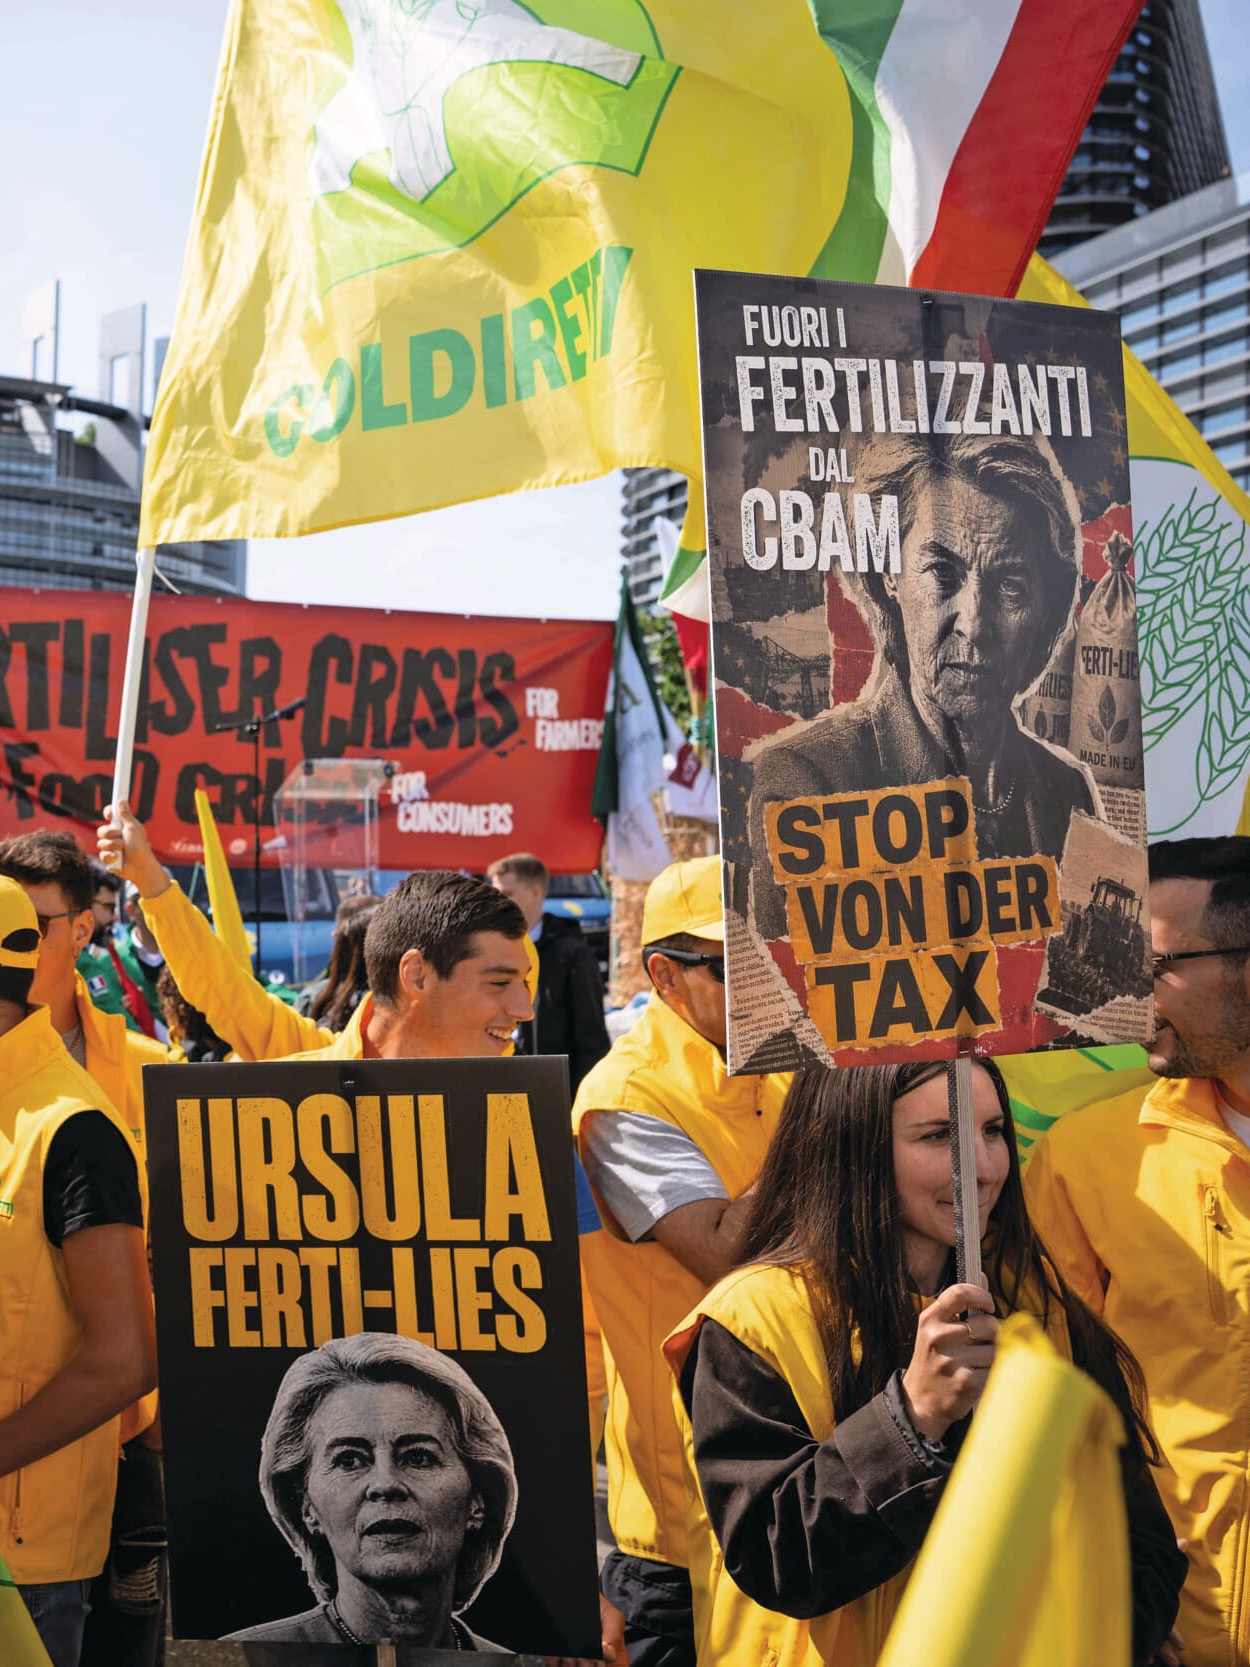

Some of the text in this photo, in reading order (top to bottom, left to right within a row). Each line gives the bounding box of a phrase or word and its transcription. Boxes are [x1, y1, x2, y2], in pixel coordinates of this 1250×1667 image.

[263, 245, 634, 459] COLDIRETTI
[742, 304, 847, 348] FUORI I
[735, 355, 1093, 438] FERTILIZZANTI
[808, 446, 854, 483] DAL
[740, 487, 902, 575] CBAM
[301, 632, 519, 760] CRISIS
[525, 687, 559, 719] FOR
[3, 742, 160, 828] FOOD
[391, 771, 429, 804] FOR
[1080, 750, 1136, 770] MADE IN EU
[397, 802, 513, 837] CONSUMERS
[776, 789, 970, 875] STOP
[796, 862, 1053, 955] VON DER
[814, 950, 995, 1043] TAX
[176, 1092, 552, 1244] URSULA
[189, 1246, 547, 1354] FERTI-LIES
